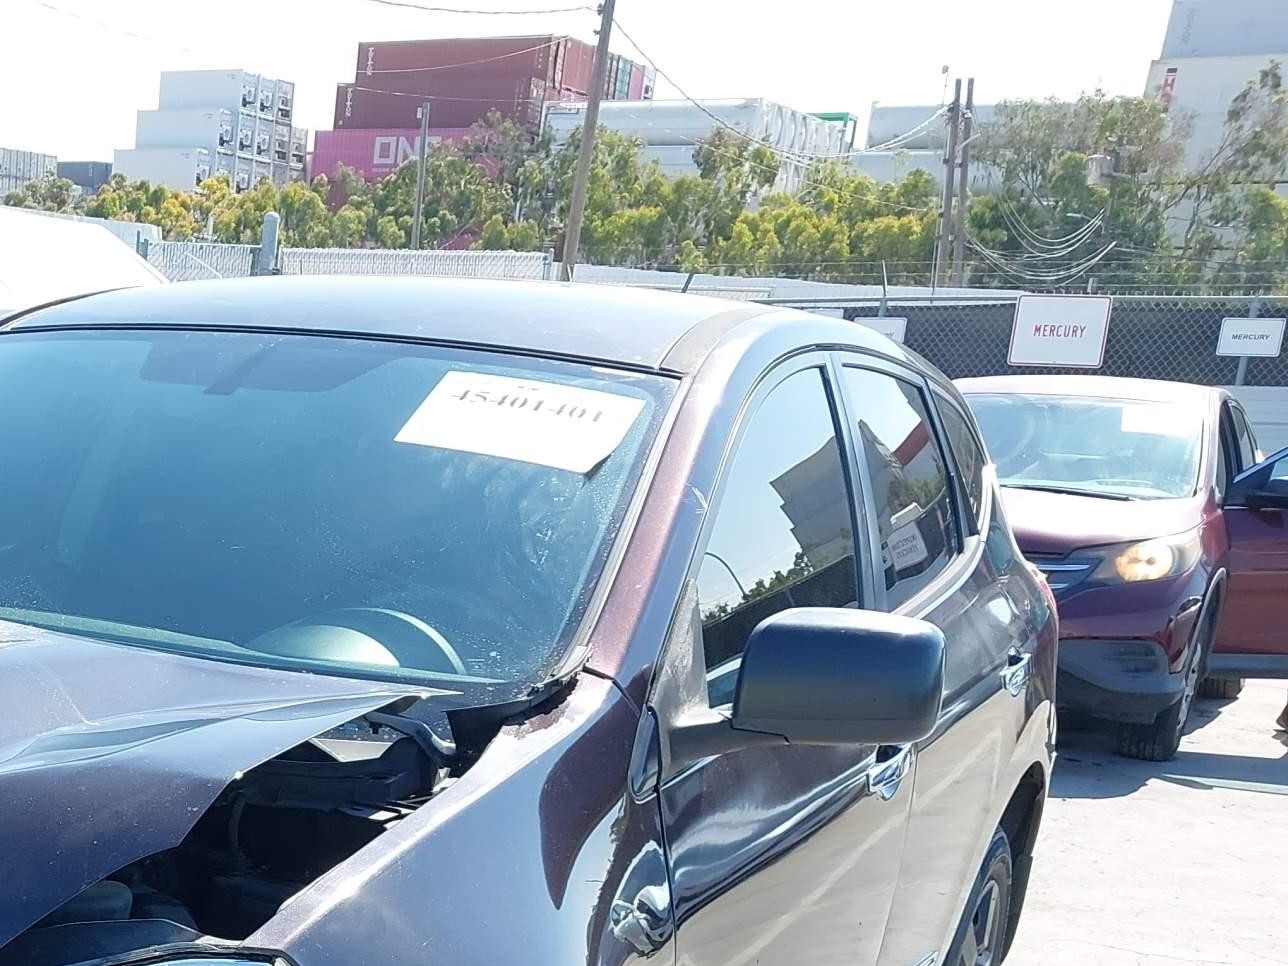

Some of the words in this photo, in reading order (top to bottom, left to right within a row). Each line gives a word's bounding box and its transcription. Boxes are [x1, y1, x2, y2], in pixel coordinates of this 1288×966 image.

[1033, 324, 1087, 338] MERCURY
[1232, 333, 1271, 341] MERCURY
[451, 389, 603, 422] 45401401
